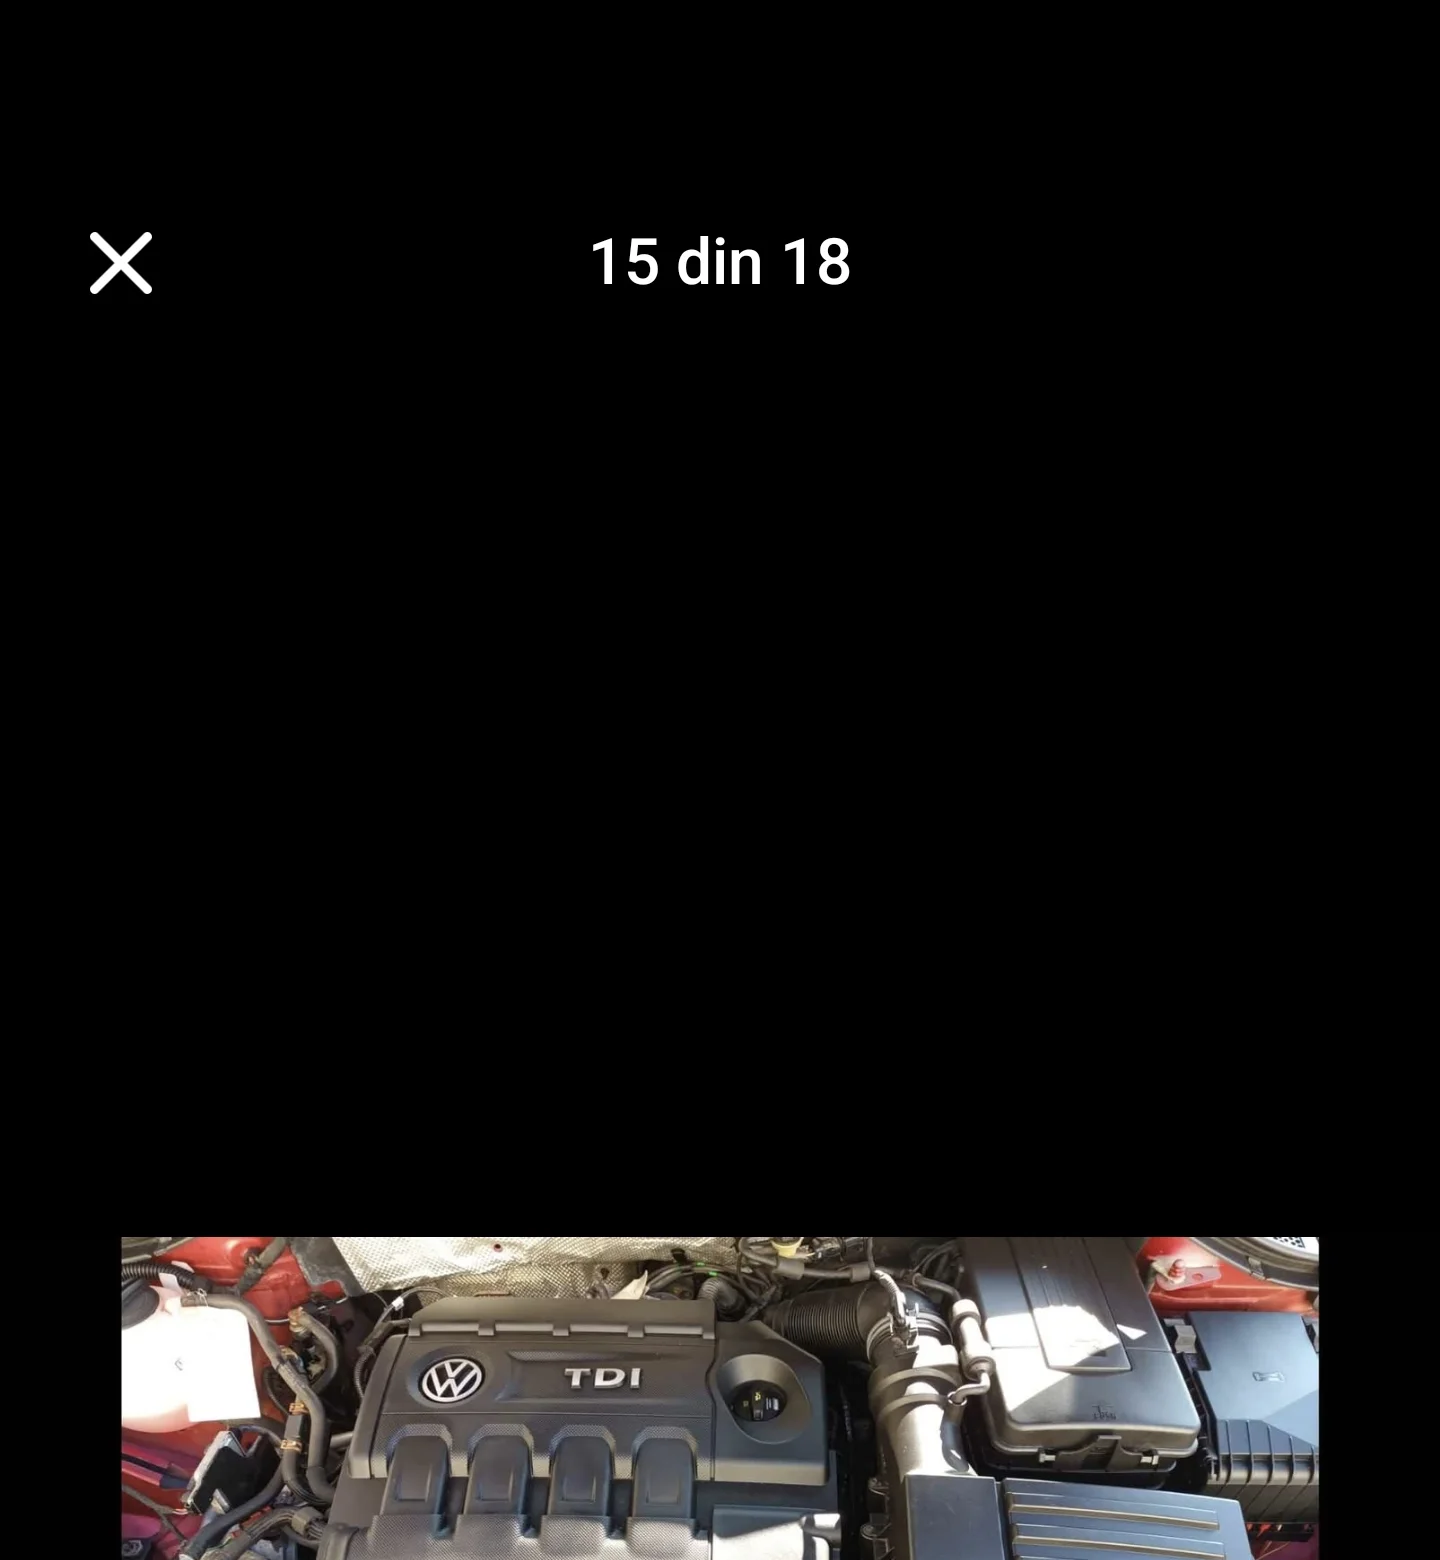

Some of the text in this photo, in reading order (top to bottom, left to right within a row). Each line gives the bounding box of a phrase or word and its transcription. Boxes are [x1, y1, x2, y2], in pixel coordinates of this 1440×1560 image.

[593, 235, 850, 285] 15 din 18
[565, 1367, 641, 1389] TDI
